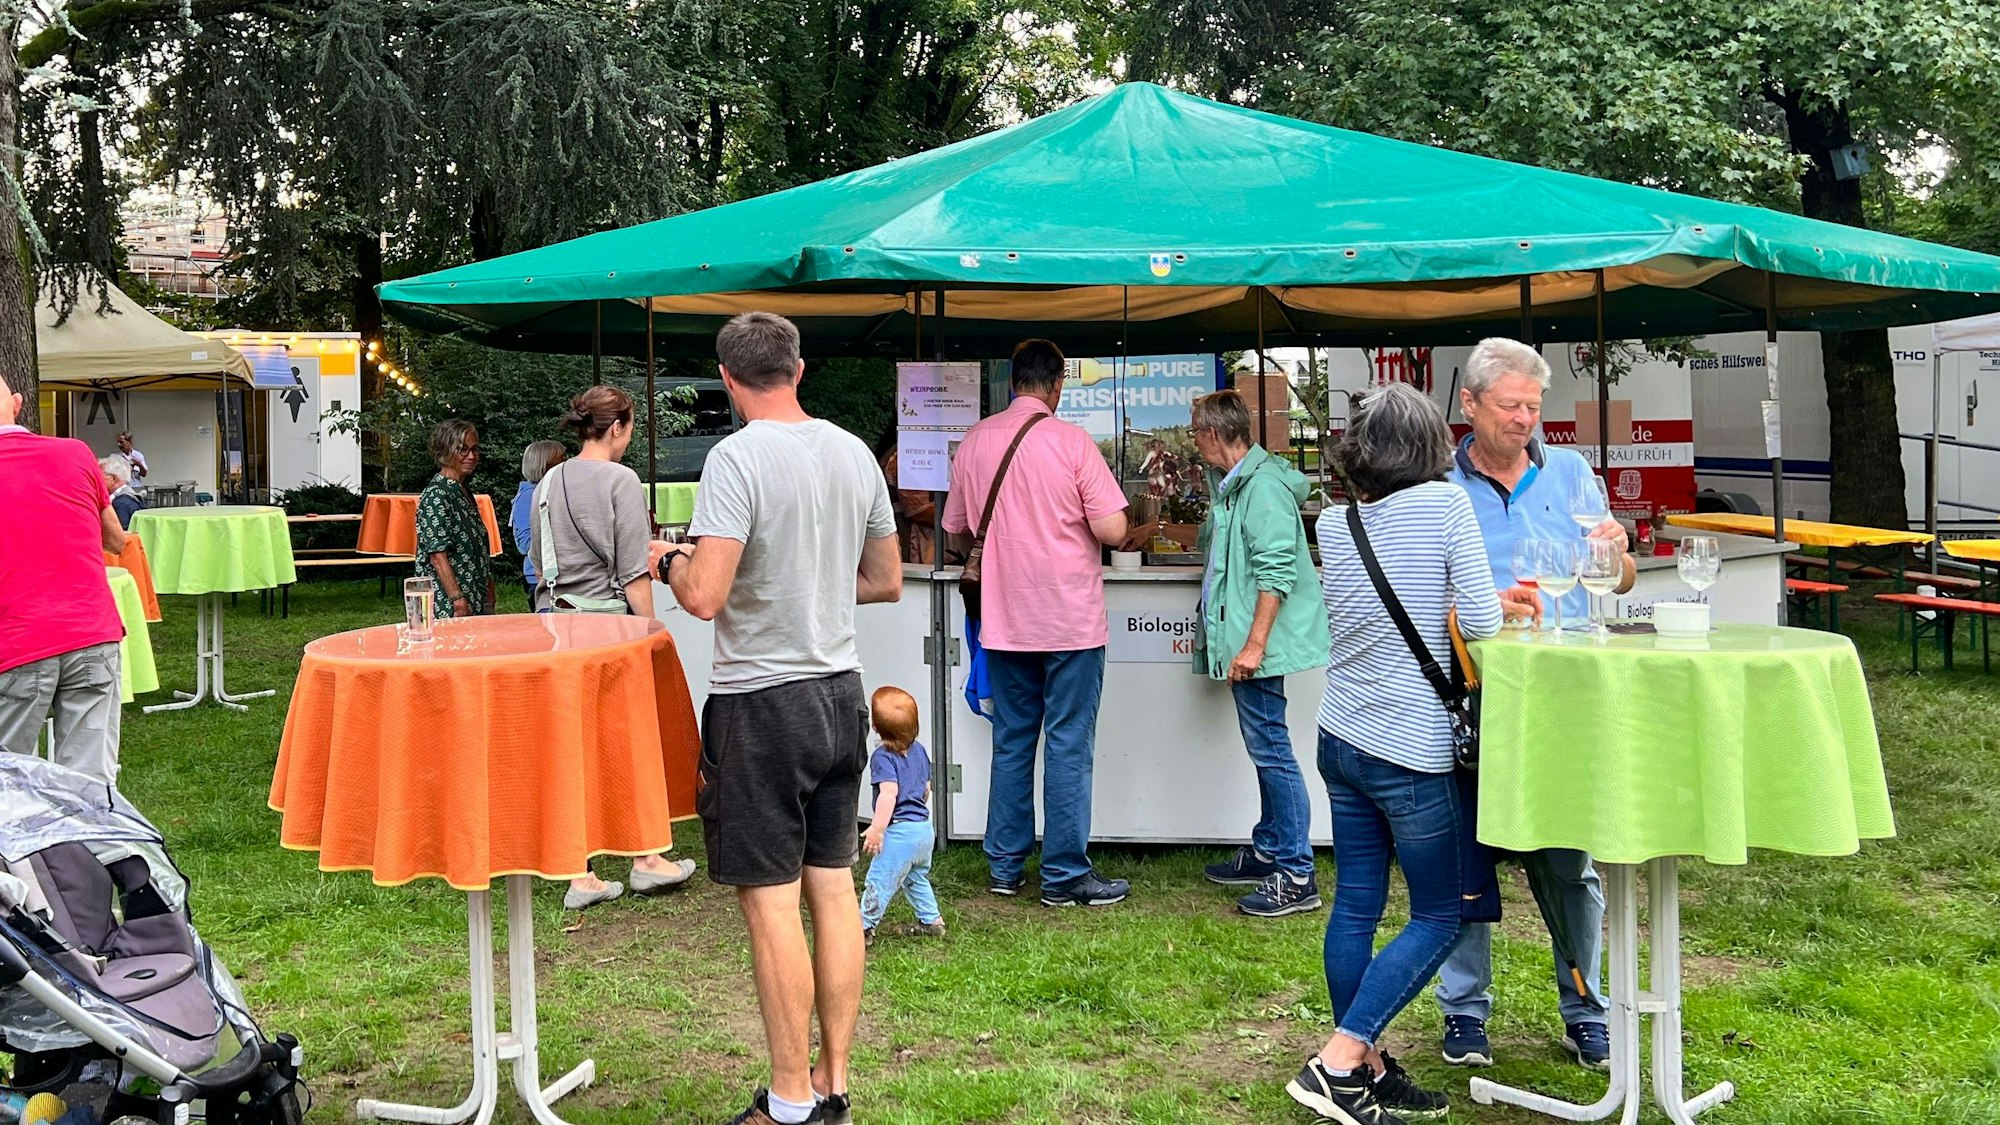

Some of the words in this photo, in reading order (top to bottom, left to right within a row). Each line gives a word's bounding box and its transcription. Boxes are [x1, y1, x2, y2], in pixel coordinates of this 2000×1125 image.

[1893, 351, 1926, 361] THO
[1150, 360, 1205, 378] PURE
[1058, 386, 1205, 408] FRISCHUNG
[1638, 446, 1671, 461] FRÜH
